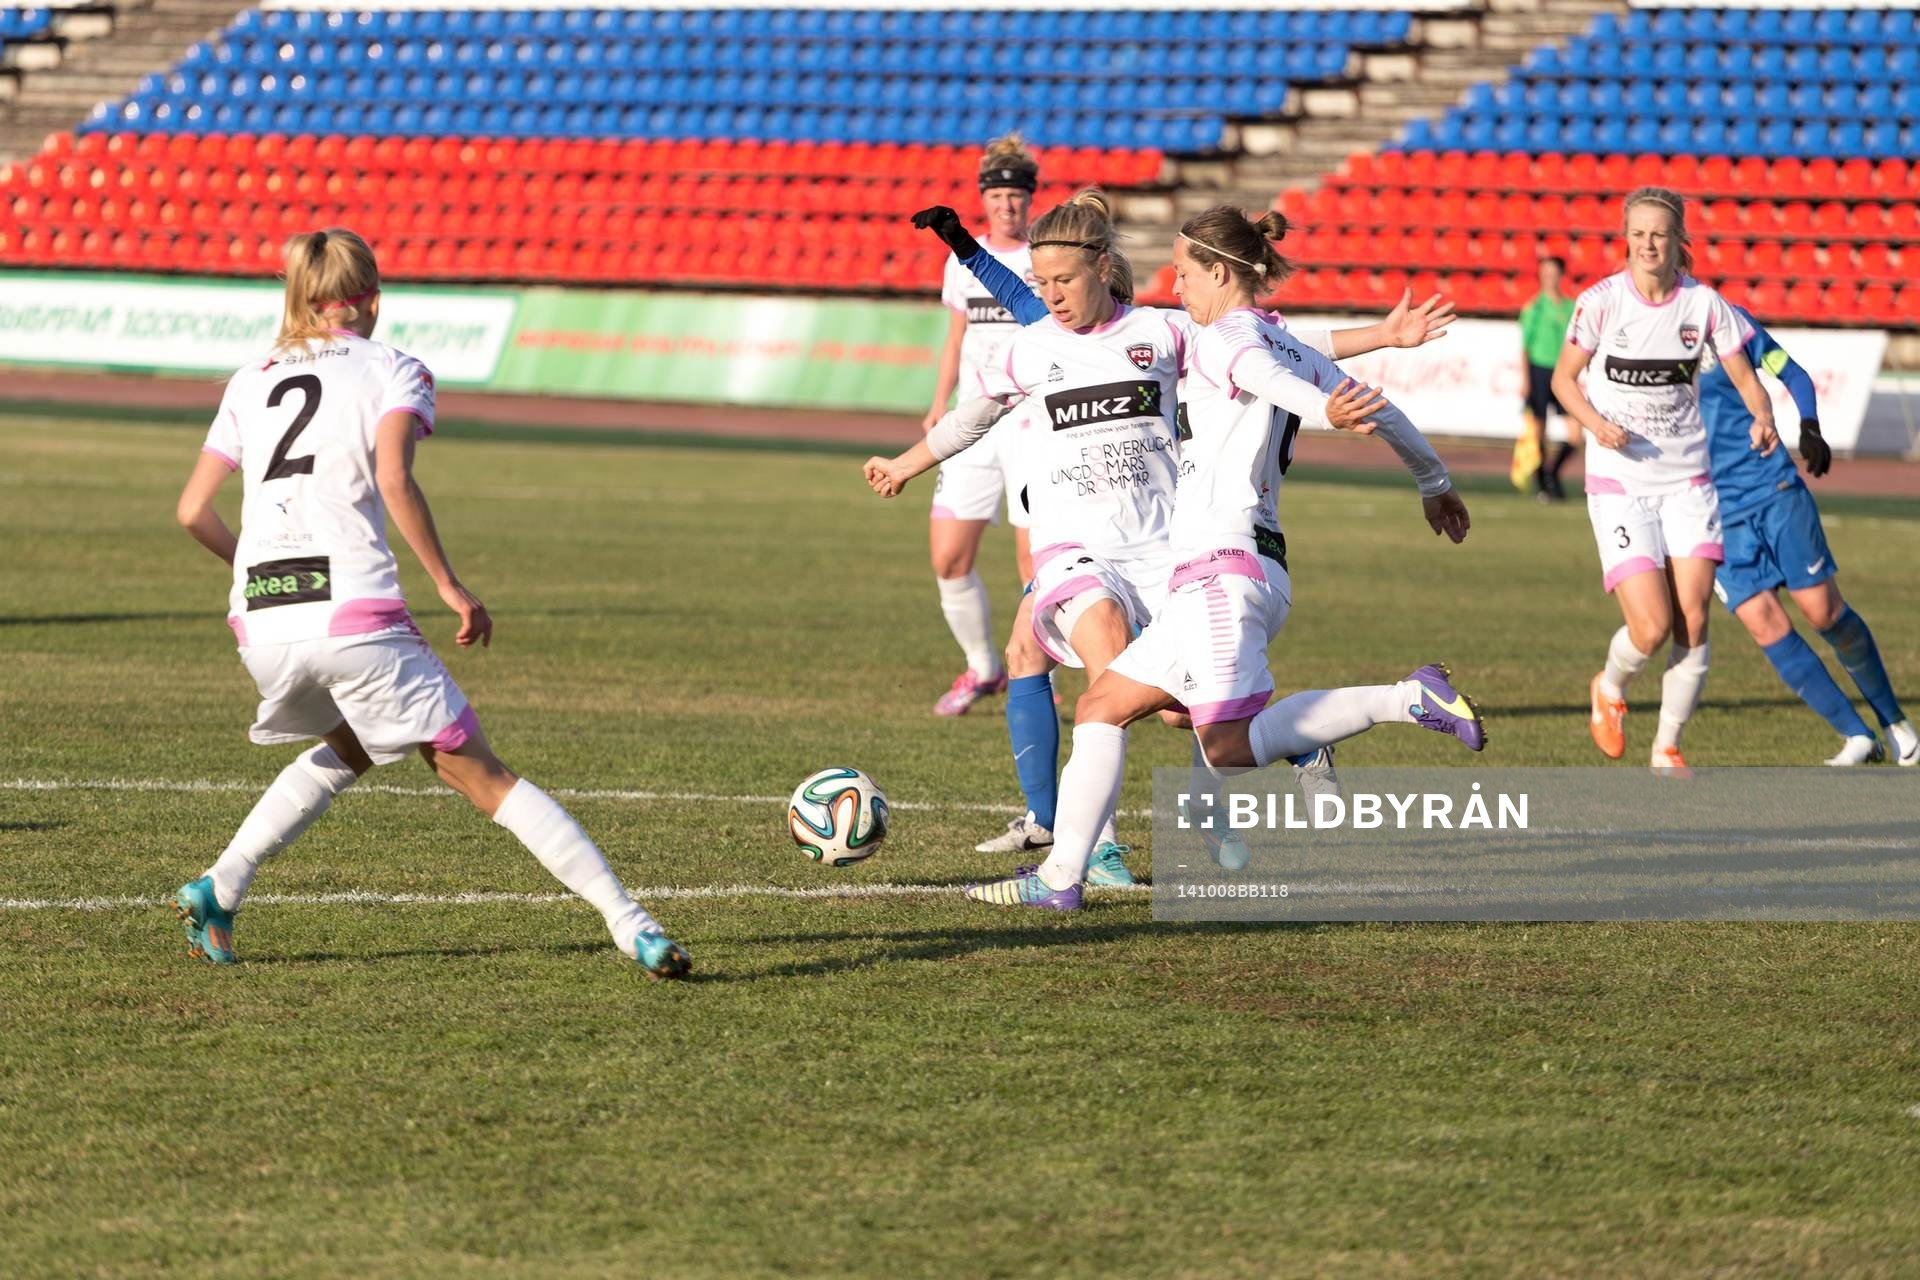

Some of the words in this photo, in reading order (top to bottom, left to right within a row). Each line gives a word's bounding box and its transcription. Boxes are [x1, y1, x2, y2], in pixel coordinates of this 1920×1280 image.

[1130, 349, 1152, 358] FCR
[1610, 367, 1672, 384] MIKZ
[1055, 396, 1132, 424] MIKZ
[262, 374, 322, 483] 2
[1614, 526, 1631, 549] 3
[1217, 548, 1245, 558] SELECT
